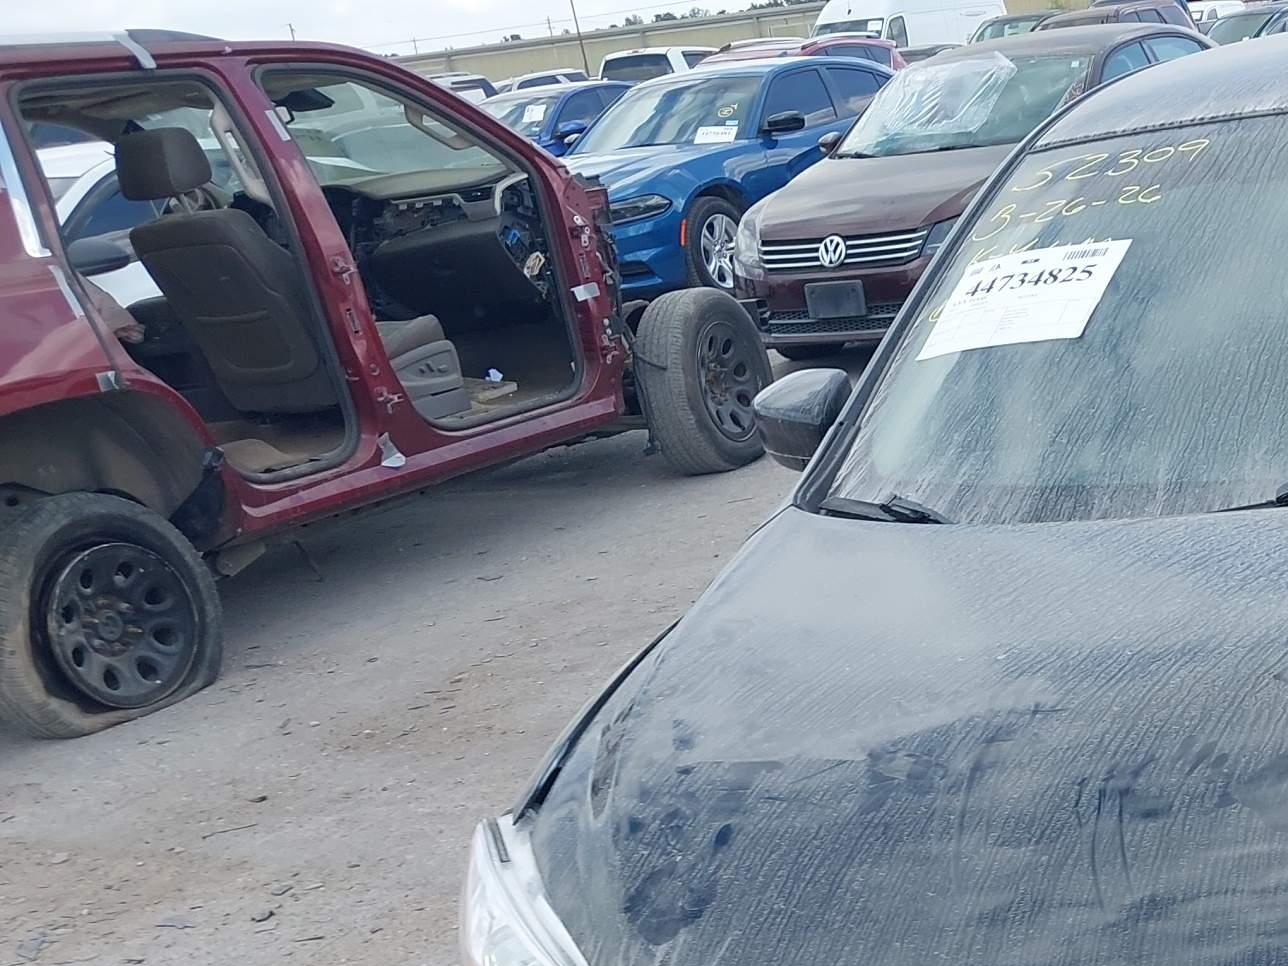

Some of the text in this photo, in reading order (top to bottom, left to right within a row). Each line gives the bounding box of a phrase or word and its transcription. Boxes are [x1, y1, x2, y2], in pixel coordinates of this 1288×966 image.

[1012, 138, 1210, 192] 52309
[819, 235, 846, 267] VW
[965, 264, 1097, 297] 44734825
